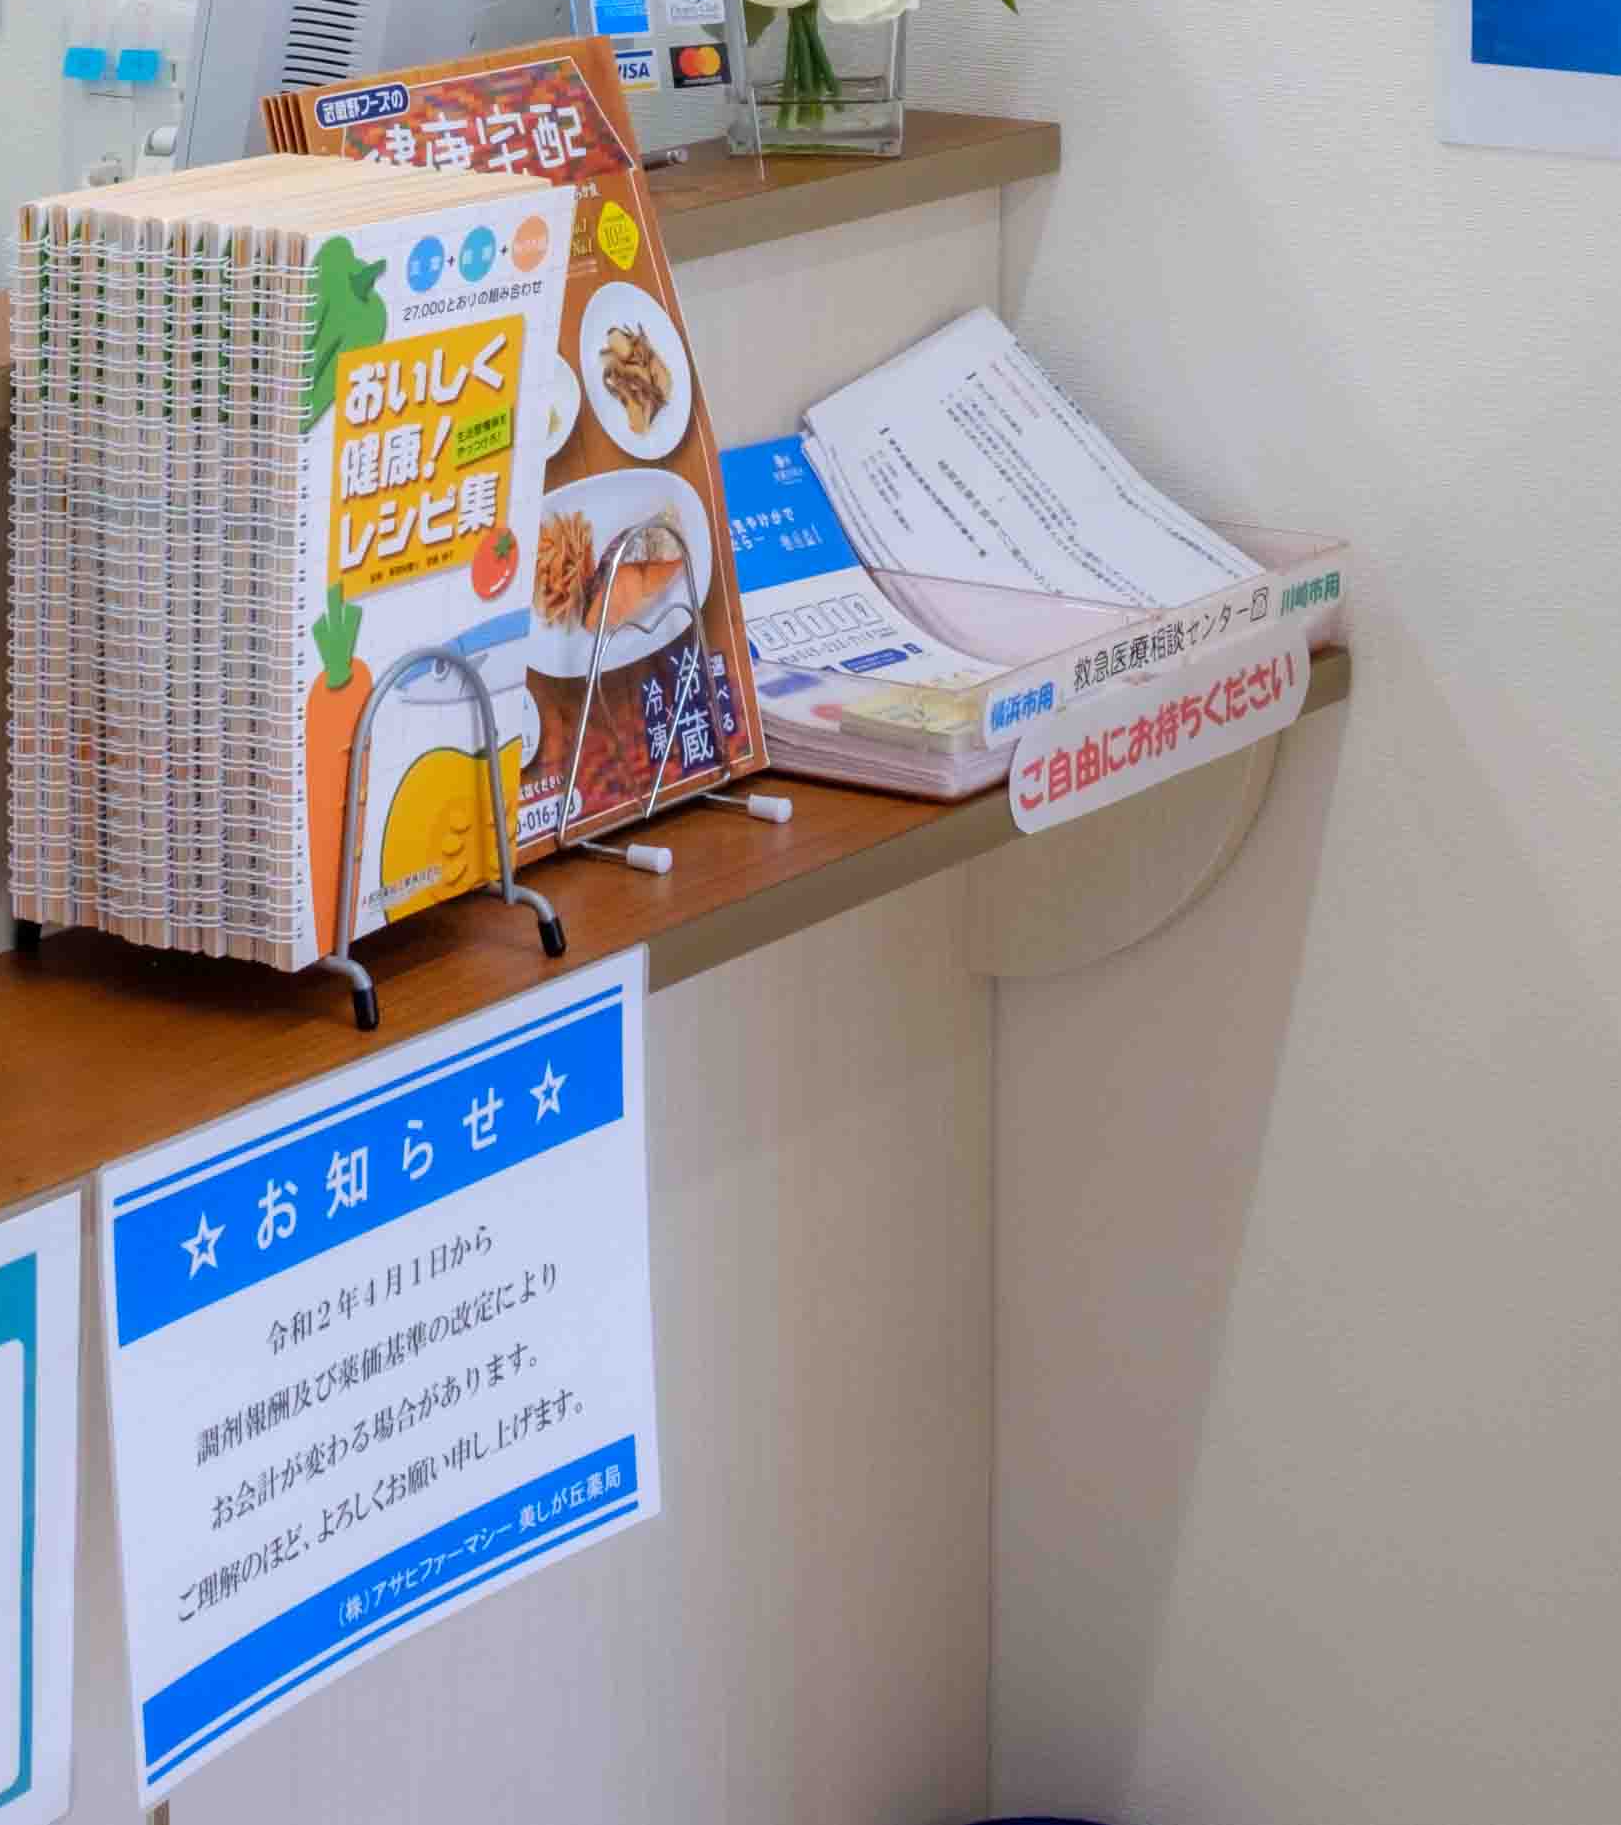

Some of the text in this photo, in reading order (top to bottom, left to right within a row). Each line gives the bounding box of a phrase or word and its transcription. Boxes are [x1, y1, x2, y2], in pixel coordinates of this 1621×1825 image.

[321, 91, 404, 123] 武蔵野フーズの
[348, 333, 510, 428] おいしく
[338, 470, 501, 572] レシピ集
[1072, 594, 1252, 690] 救急医療相談センター
[1279, 574, 1340, 617] 川崎市用
[991, 680, 1055, 734] 横浜市用
[1017, 652, 1294, 812] ご自由にお持ちください
[267, 1224, 494, 1356] 令和2年4月1日から
[196, 1260, 558, 1466] 調剤報酬及び薬価基準の改定により
[210, 1340, 539, 1527] お会計が変わる場合があります。
[176, 1391, 583, 1622] ご理解のほど、よろしくお願い申し上げます。
[518, 1465, 621, 1534] 美しが丘薬局
